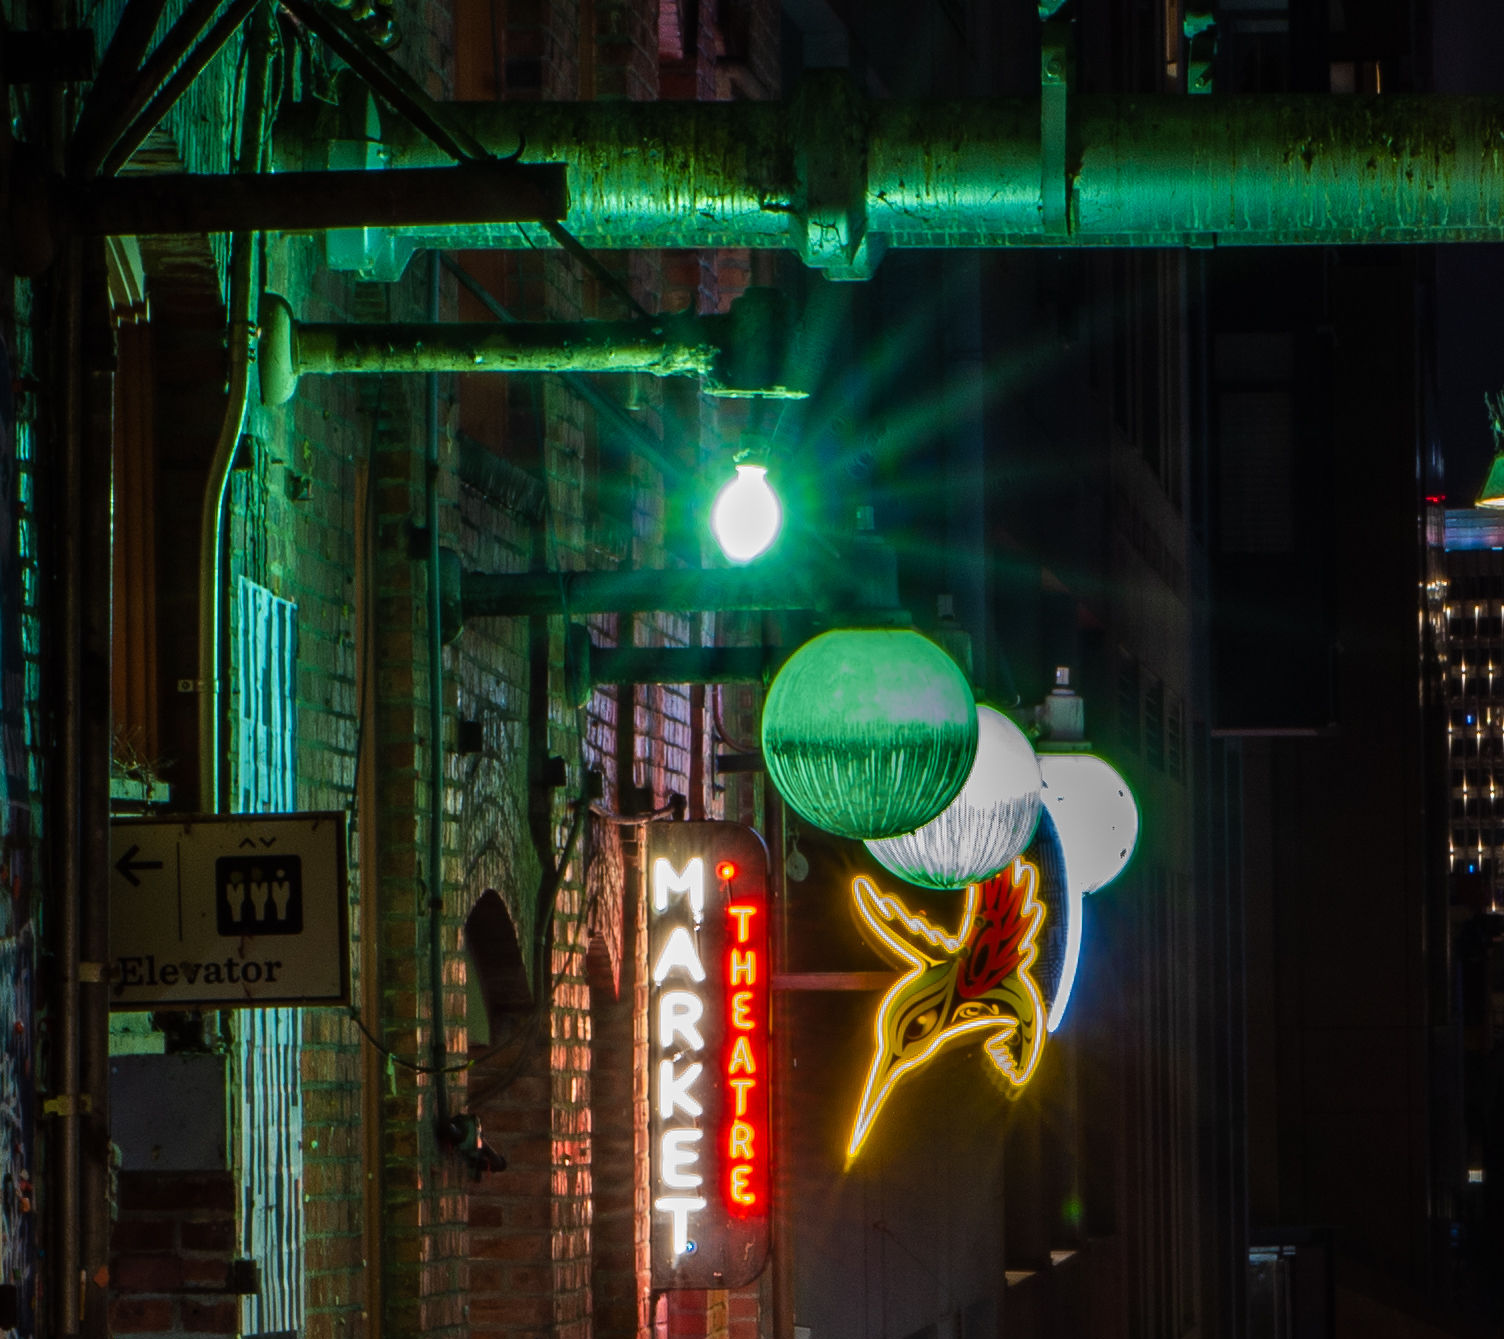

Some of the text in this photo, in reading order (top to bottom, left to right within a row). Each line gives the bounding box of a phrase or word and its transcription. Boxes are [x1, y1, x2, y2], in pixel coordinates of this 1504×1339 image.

[117, 954, 282, 986] Elevator
[652, 856, 706, 1256] MARKET
[728, 906, 756, 1205] THEATRE
